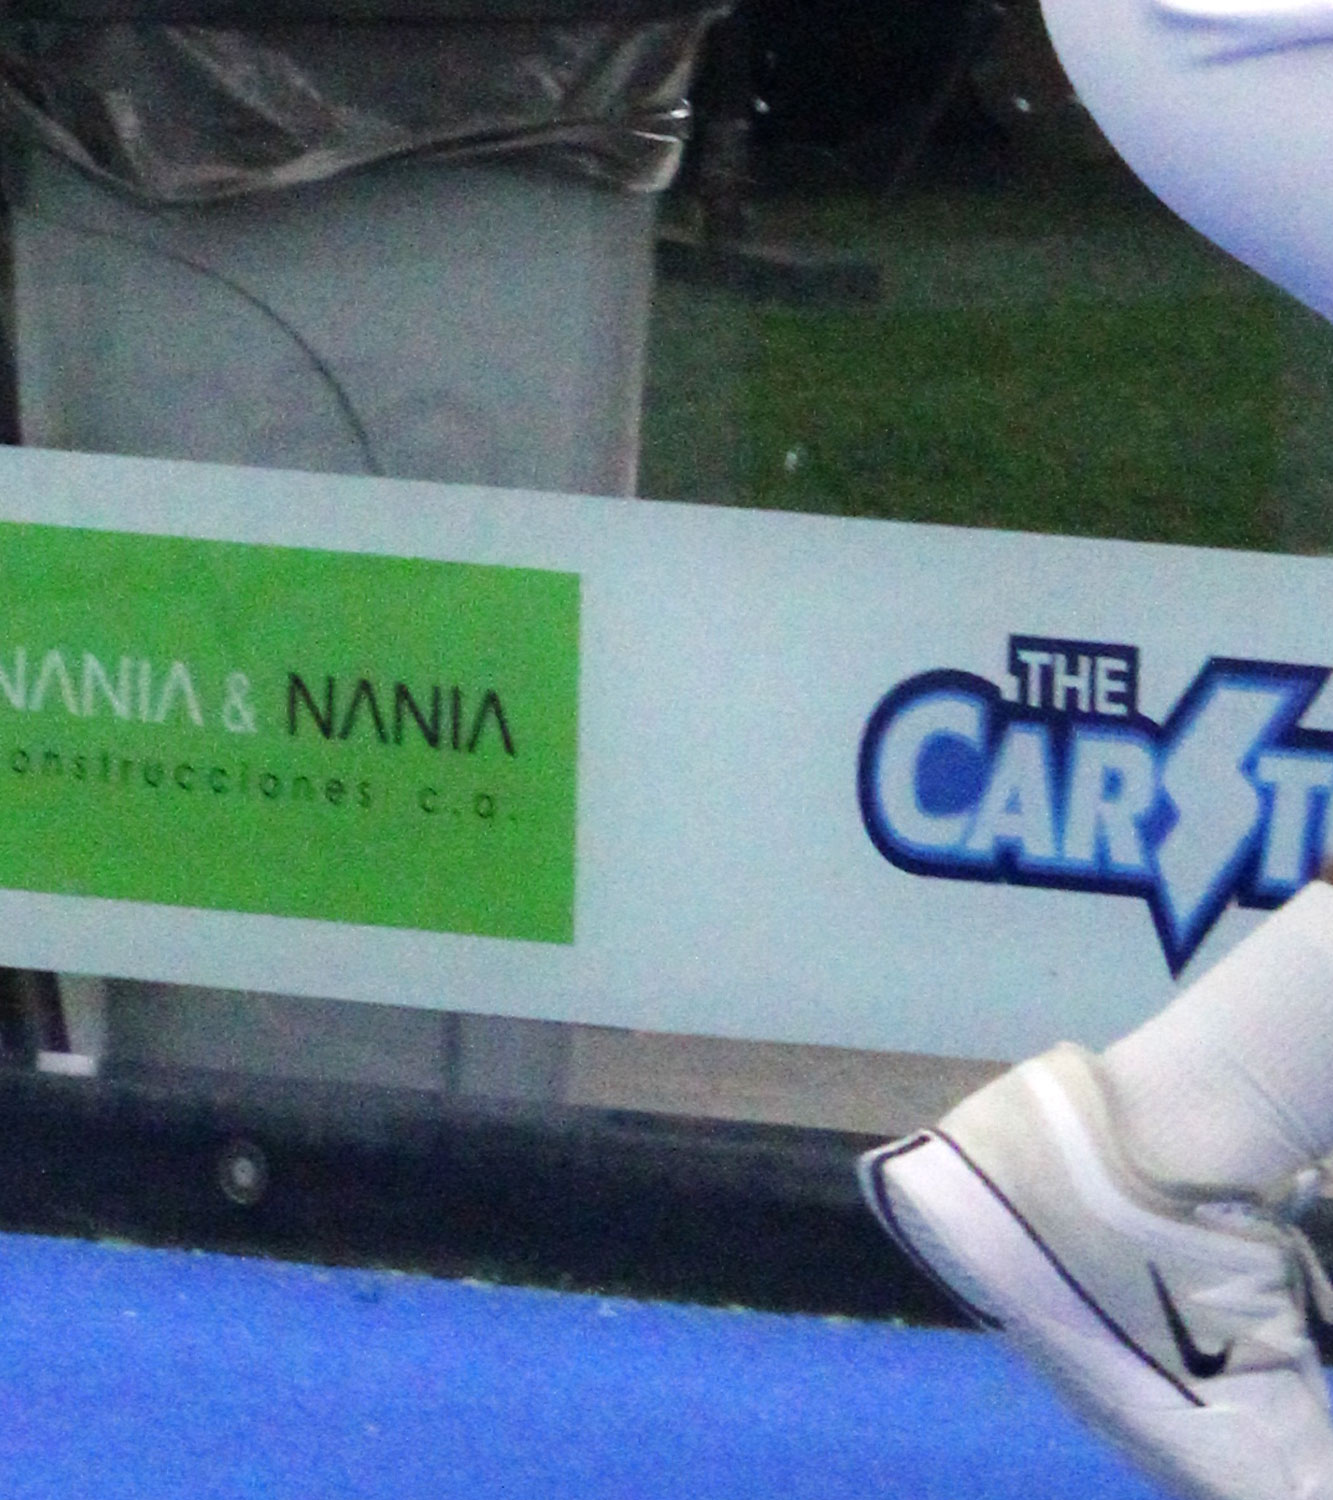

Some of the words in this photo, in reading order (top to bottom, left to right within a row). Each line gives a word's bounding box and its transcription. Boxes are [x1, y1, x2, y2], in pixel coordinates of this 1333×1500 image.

[222, 671, 257, 733] &
[286, 672, 517, 758] NANIA
[1014, 646, 1131, 717] THE
